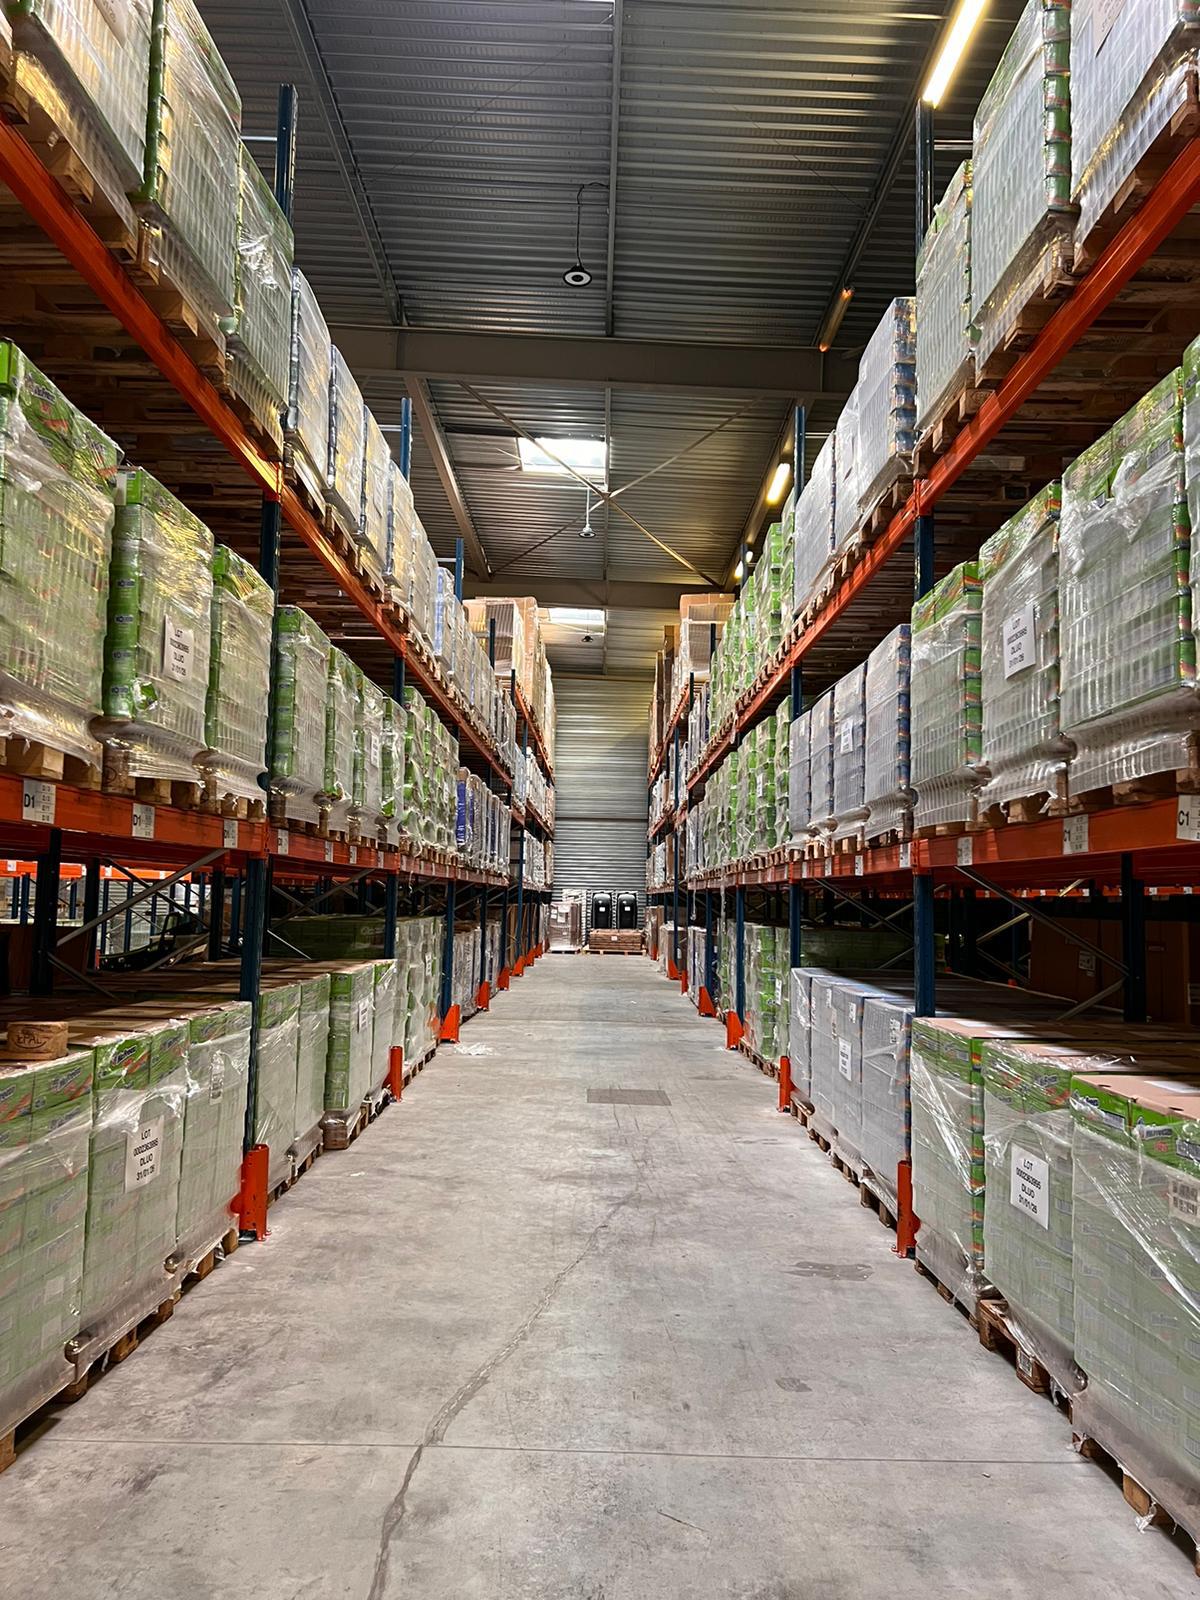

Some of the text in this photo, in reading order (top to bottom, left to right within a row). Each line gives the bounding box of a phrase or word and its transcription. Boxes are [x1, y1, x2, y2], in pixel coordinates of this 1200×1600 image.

[24, 793, 35, 808] D1
[133, 814, 141, 826] D1
[1178, 810, 1190, 826] C1
[17, 1033, 43, 1045] EPAL
[141, 1129, 151, 1140] LOT
[140, 1153, 153, 1166] DLUO
[1023, 1159, 1033, 1172] LOT
[1021, 1183, 1035, 1199] DLUO
